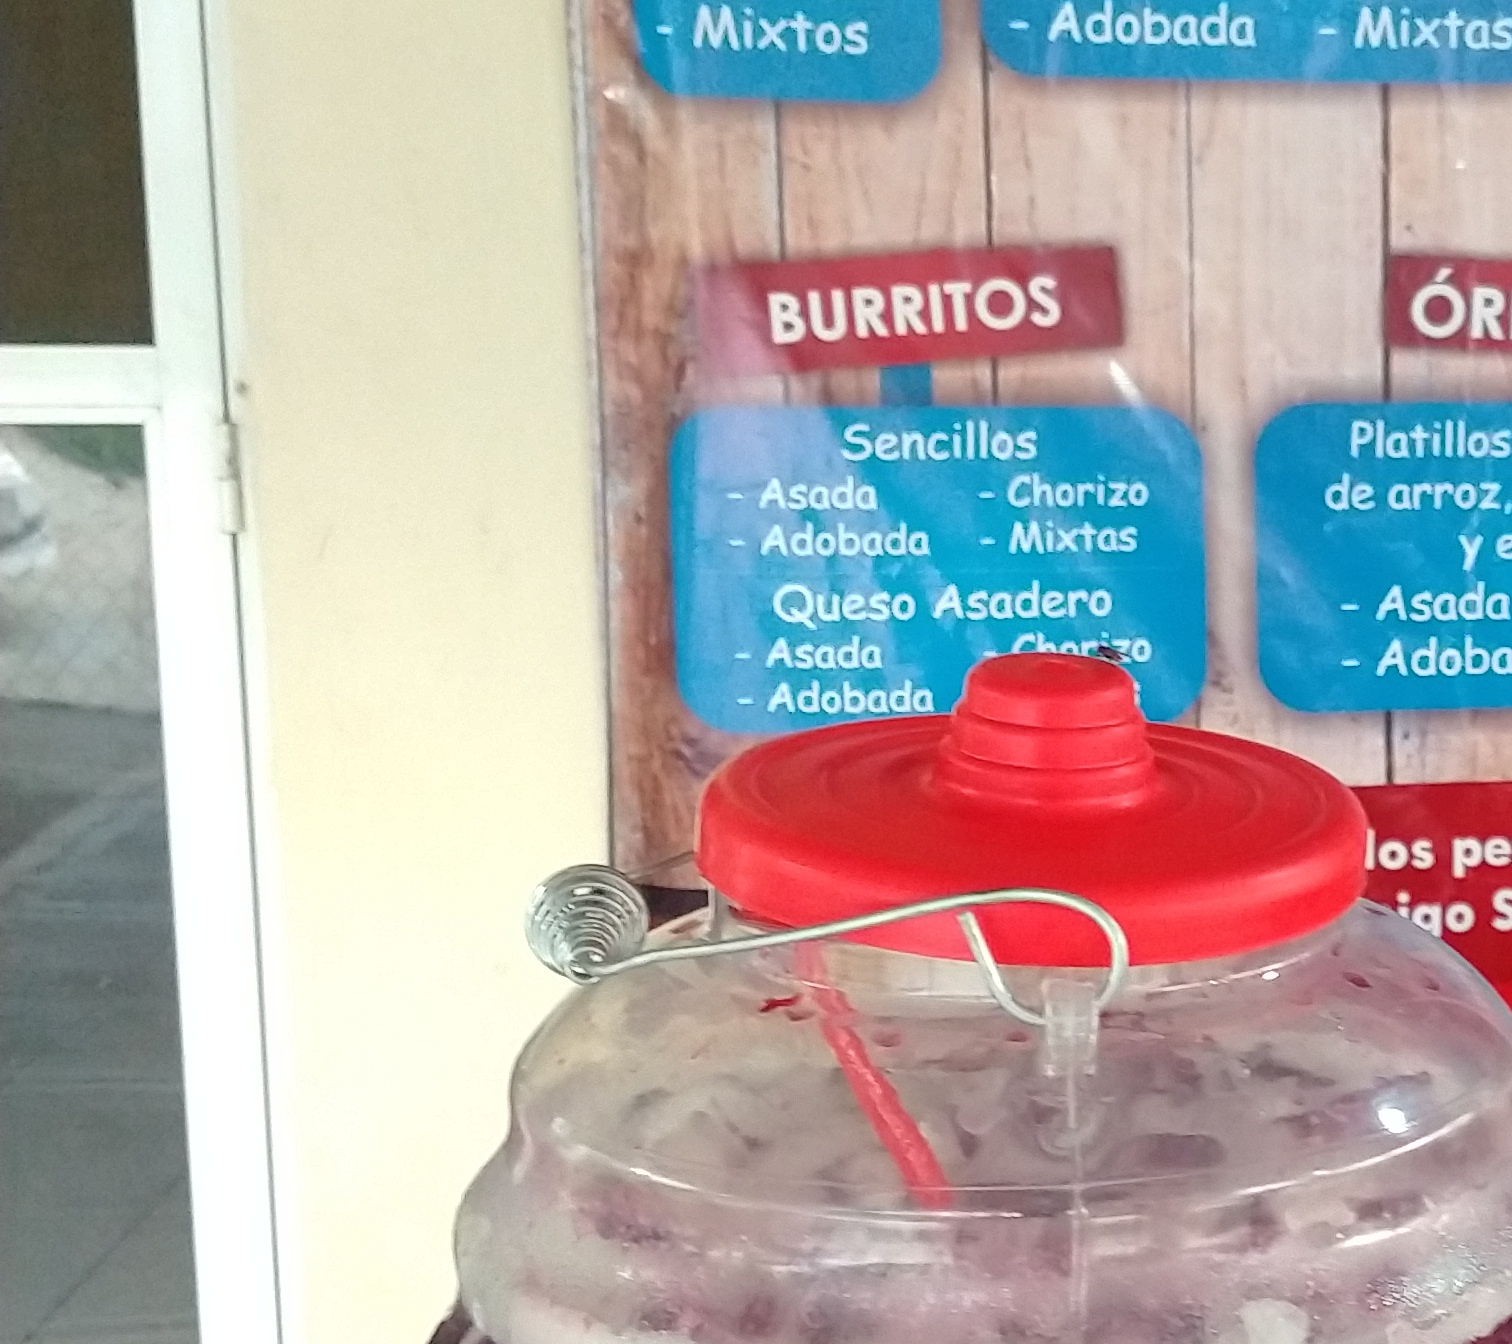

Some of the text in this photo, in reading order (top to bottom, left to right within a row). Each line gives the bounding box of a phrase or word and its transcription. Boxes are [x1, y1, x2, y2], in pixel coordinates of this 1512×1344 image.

[693, 5, 869, 55] Mixtos
[1047, 0, 1257, 48] Adobada
[766, 274, 1062, 345] BURRITOS
[841, 419, 1039, 462] Sencillos
[1350, 419, 1512, 460] Platillos
[758, 474, 1149, 512] Asada Chorizo
[1324, 473, 1375, 511] de
[759, 520, 1138, 557] Adobada Mixtas
[1459, 532, 1484, 571] y
[772, 579, 1113, 630] Queso Asadero
[1375, 582, 1511, 623] Asada
[765, 636, 883, 670] Asada
[766, 681, 935, 714] Adobada
